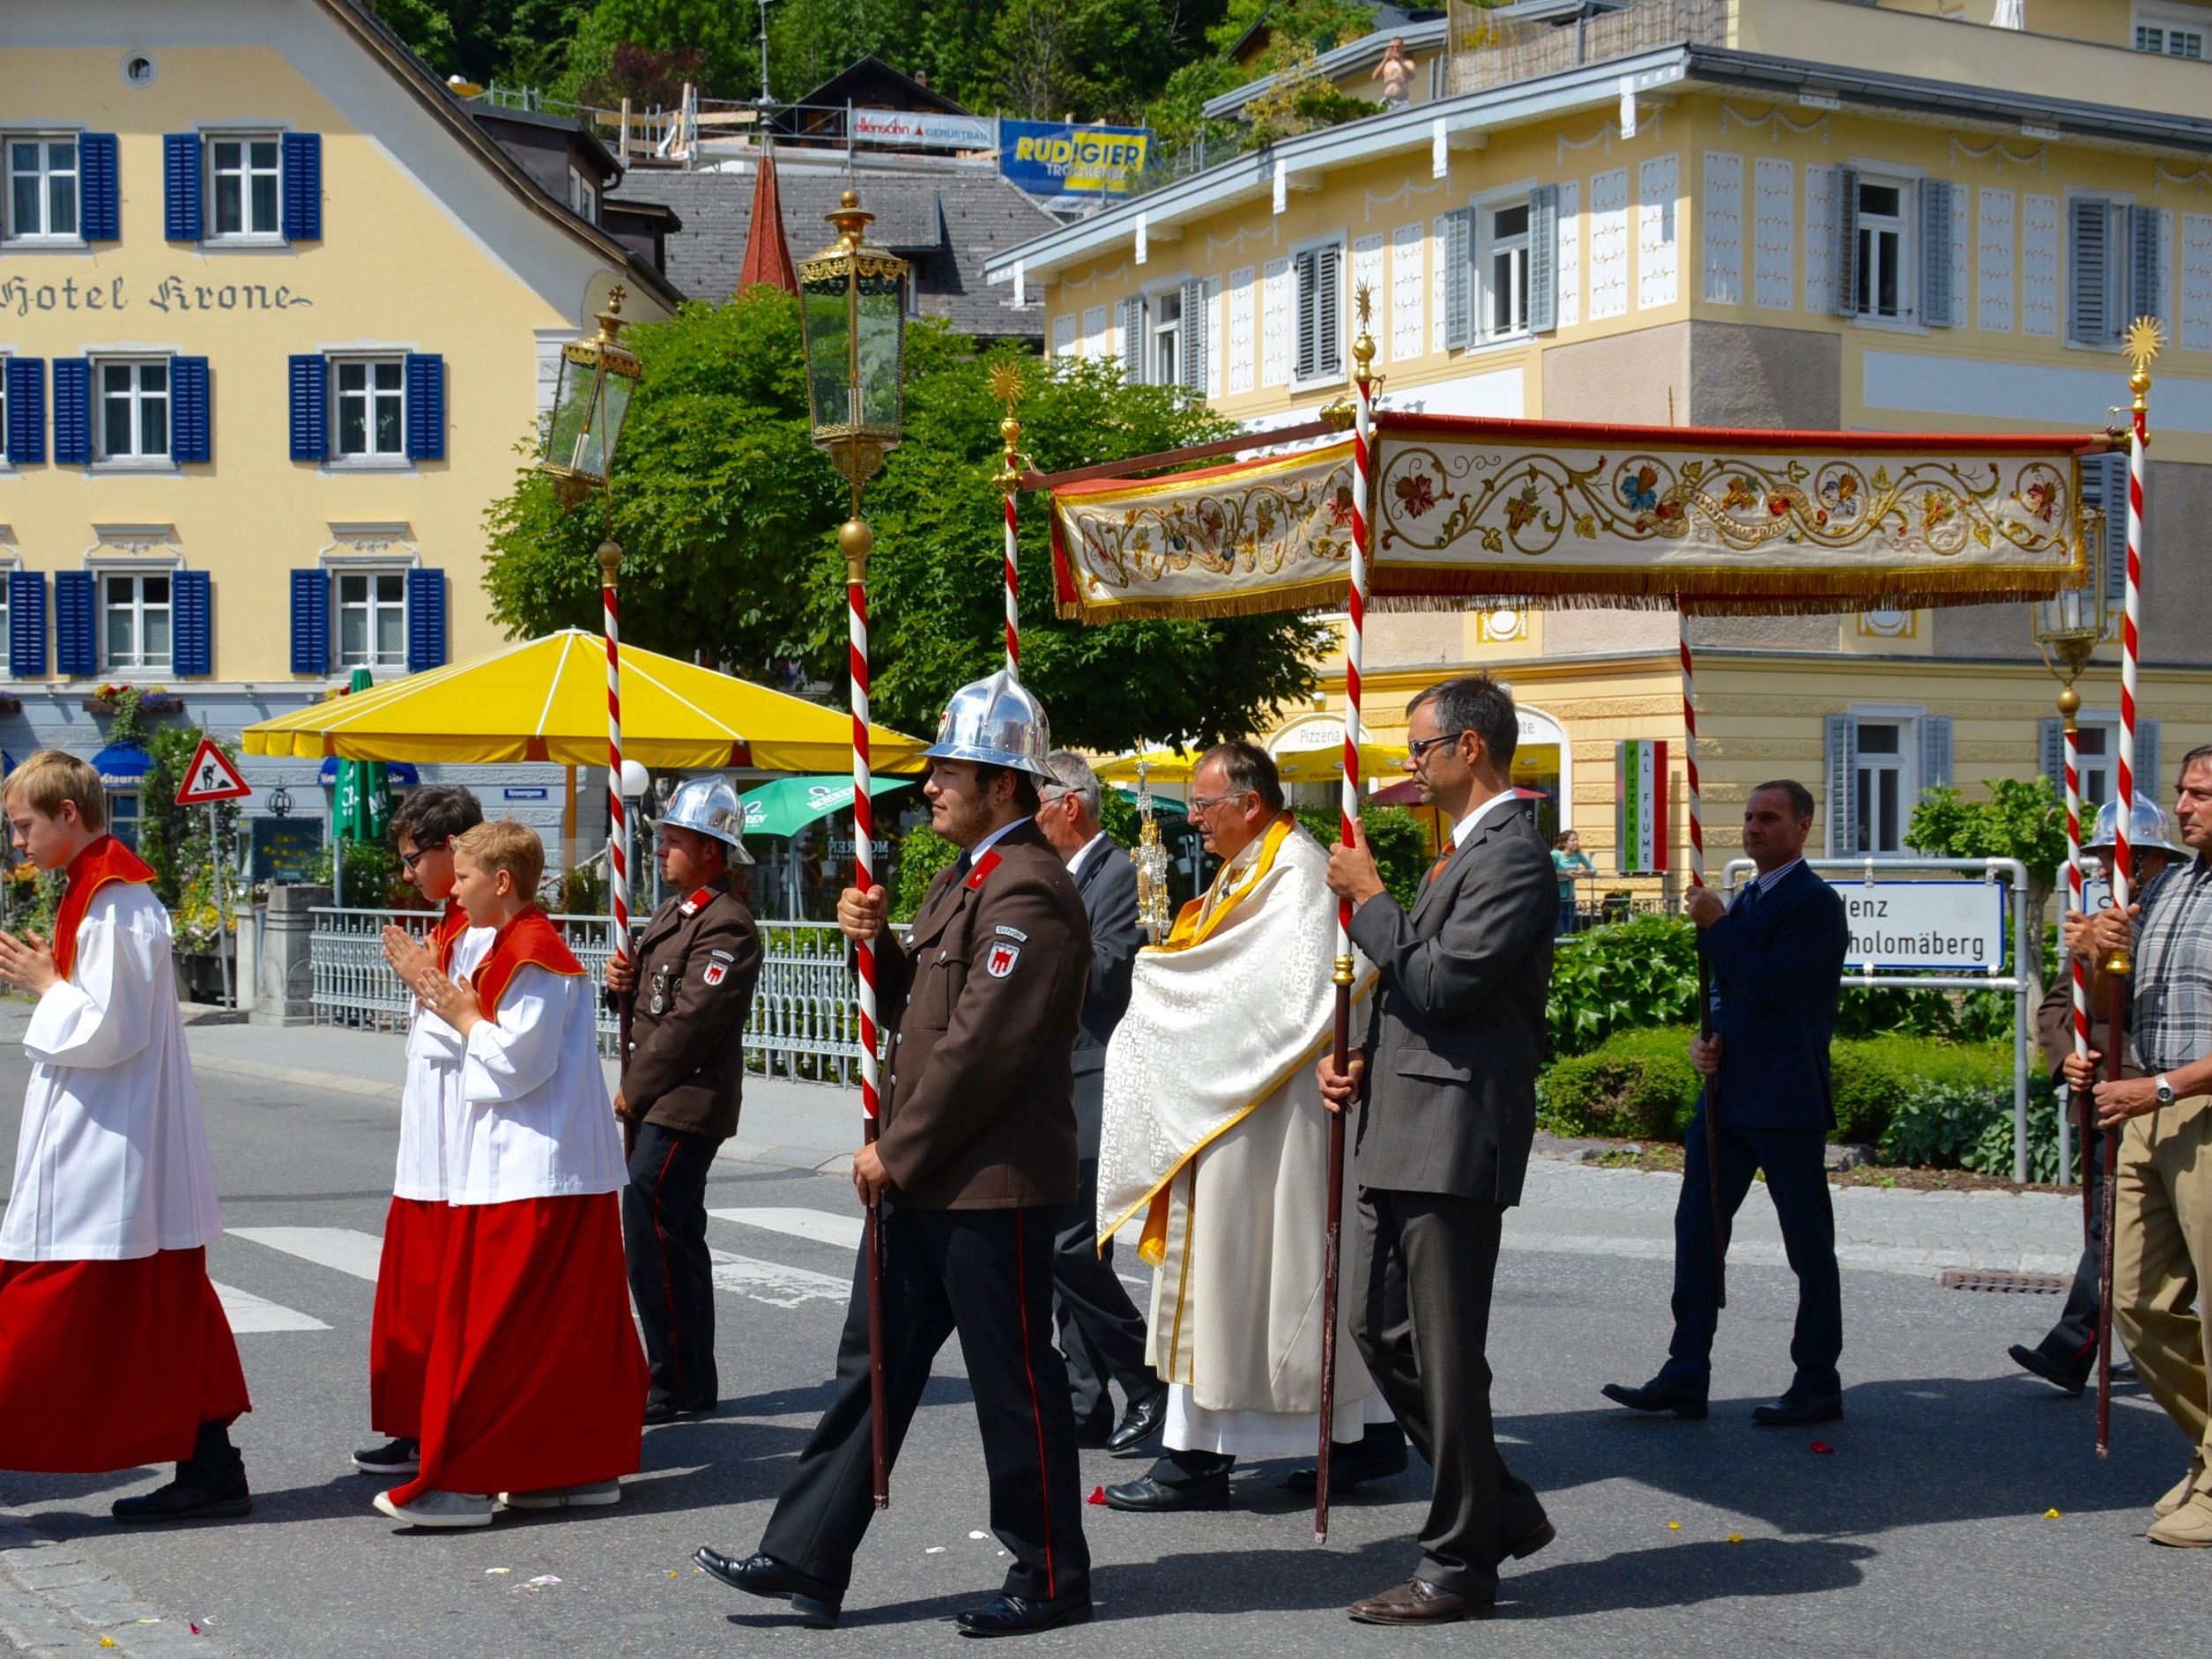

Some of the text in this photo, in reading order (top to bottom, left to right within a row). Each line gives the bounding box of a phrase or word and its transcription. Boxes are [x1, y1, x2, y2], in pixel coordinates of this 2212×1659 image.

[1015, 136, 1139, 167] RUDIGIER
[0, 276, 313, 317] Hotel Krone
[1300, 730, 1340, 743] Pizzeria
[1642, 749, 1651, 863] AL FIUME
[1849, 930, 1984, 961] holomäberg
